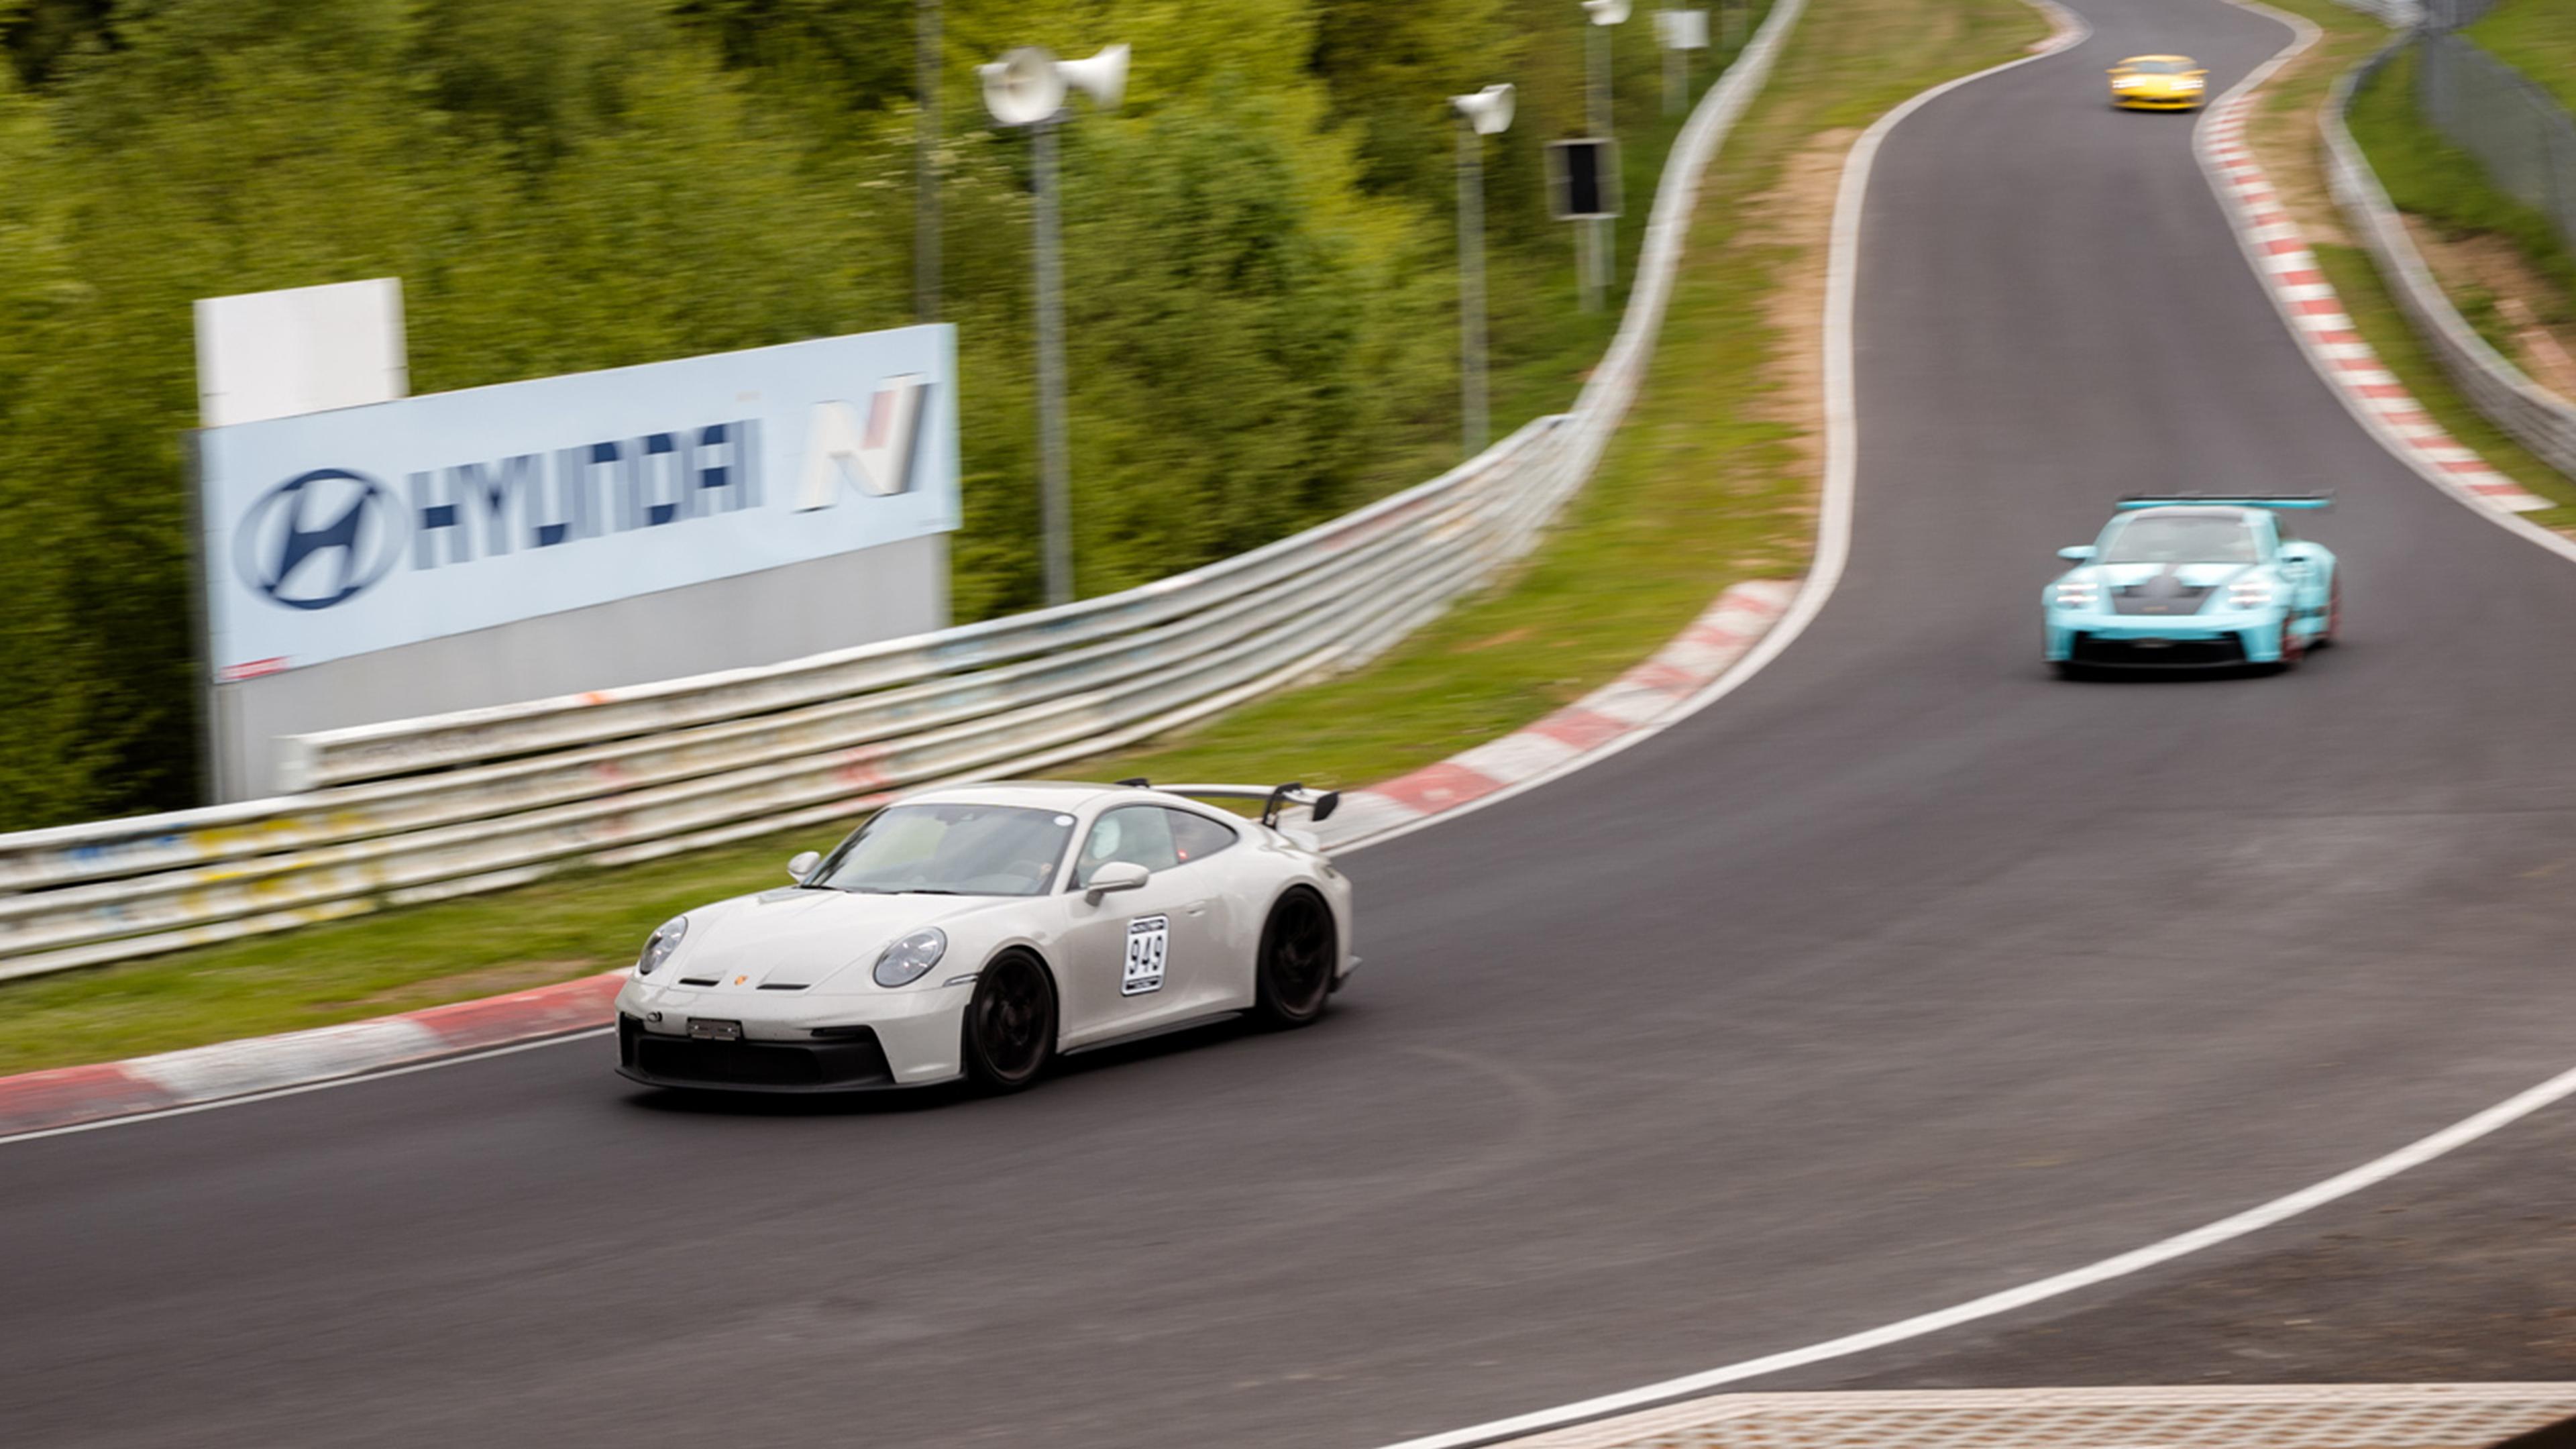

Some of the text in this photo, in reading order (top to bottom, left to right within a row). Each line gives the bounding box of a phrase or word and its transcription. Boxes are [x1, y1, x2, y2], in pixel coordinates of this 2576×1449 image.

[408, 417, 763, 572] HYUNDAI
[793, 373, 939, 514] N
[1128, 934, 1163, 975] 949
